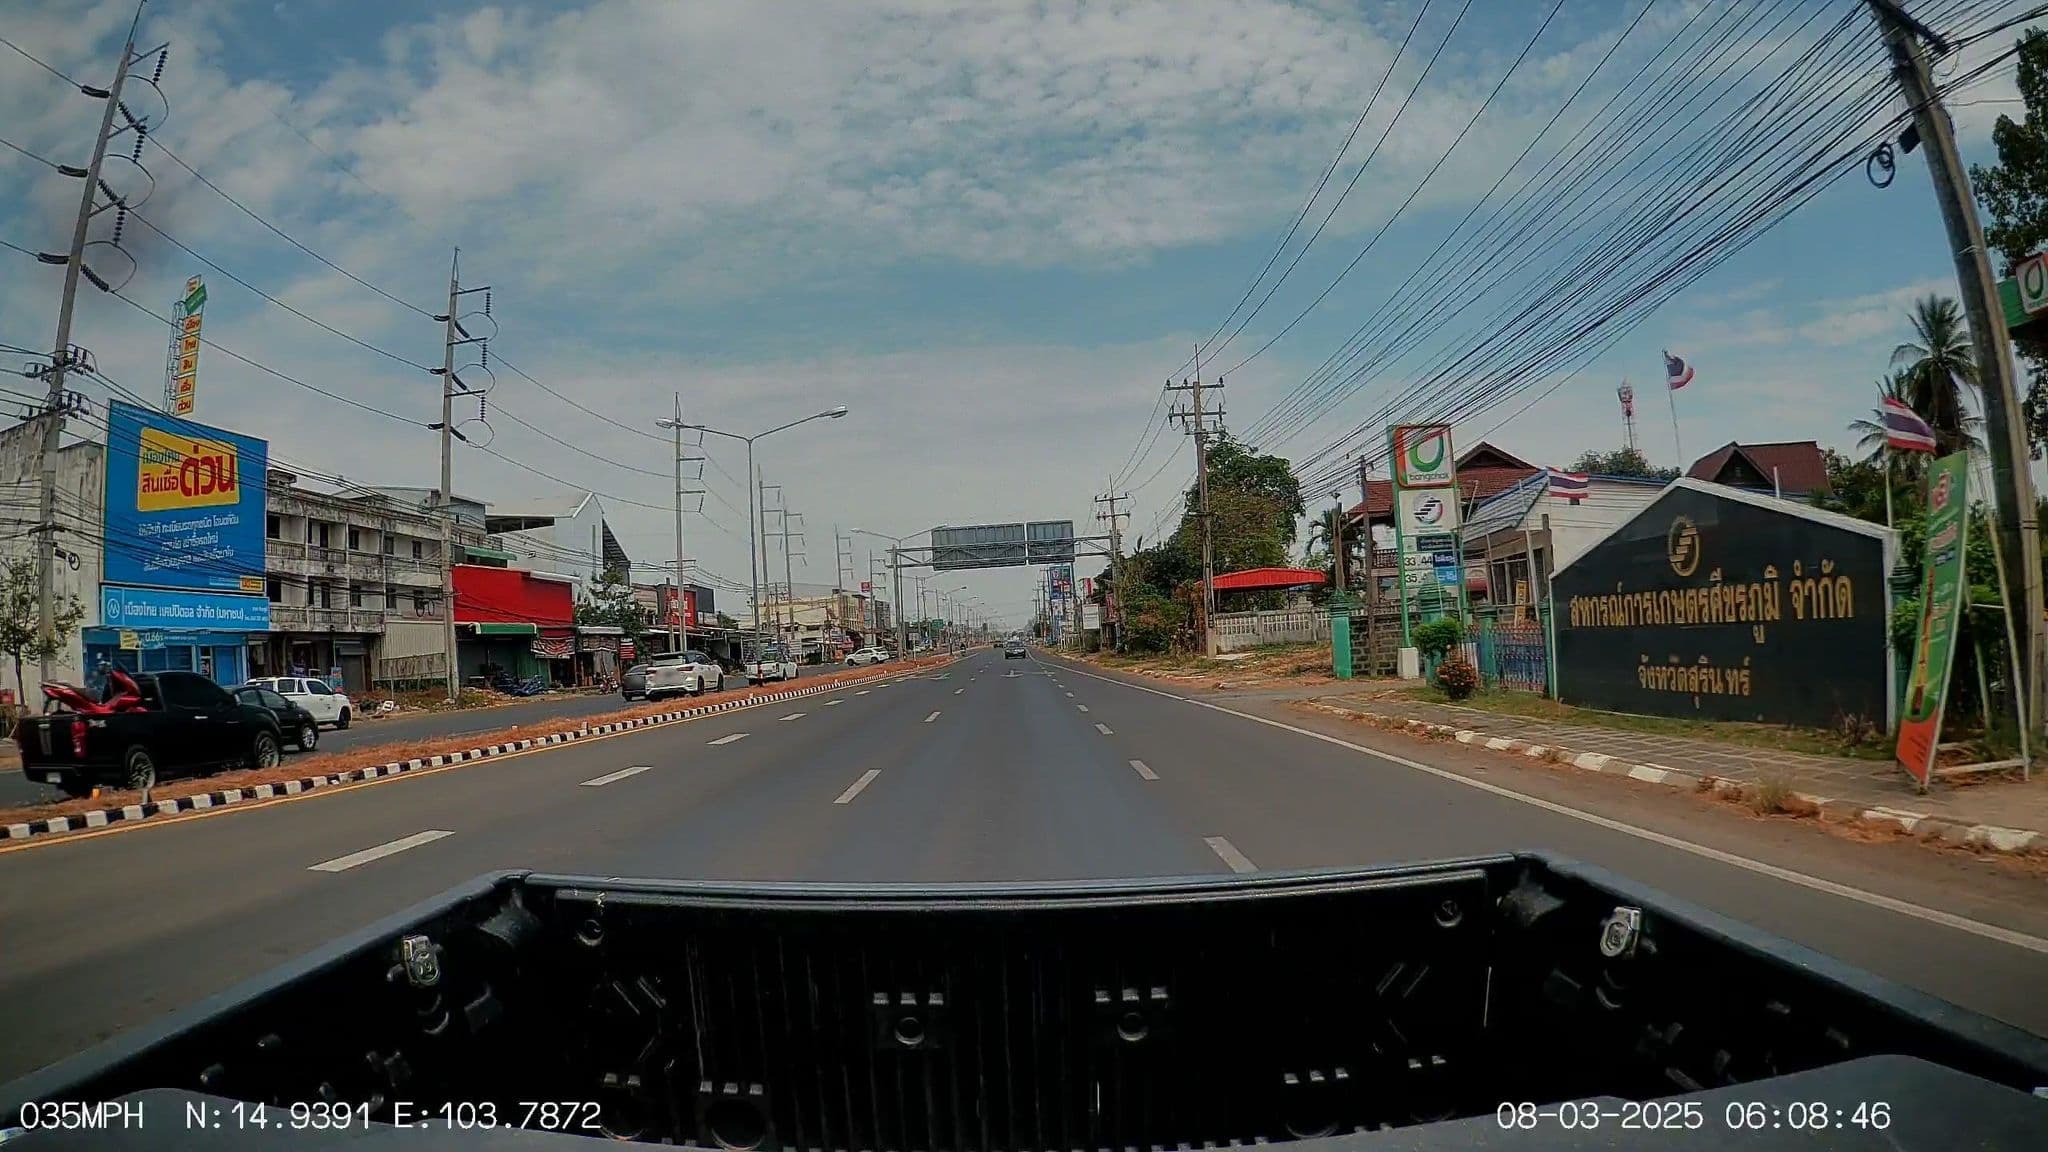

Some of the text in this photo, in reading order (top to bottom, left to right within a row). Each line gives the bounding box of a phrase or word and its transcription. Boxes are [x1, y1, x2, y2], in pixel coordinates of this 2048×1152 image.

[142, 445, 235, 497] สินเชื่อ ด่วน
[124, 601, 157, 616] เมืองไทย
[196, 604, 215, 618] จำกัด
[1569, 564, 1781, 643] สหกรณ์การเกษตรศีขรภูมิ
[1789, 559, 1854, 620] จำกัด
